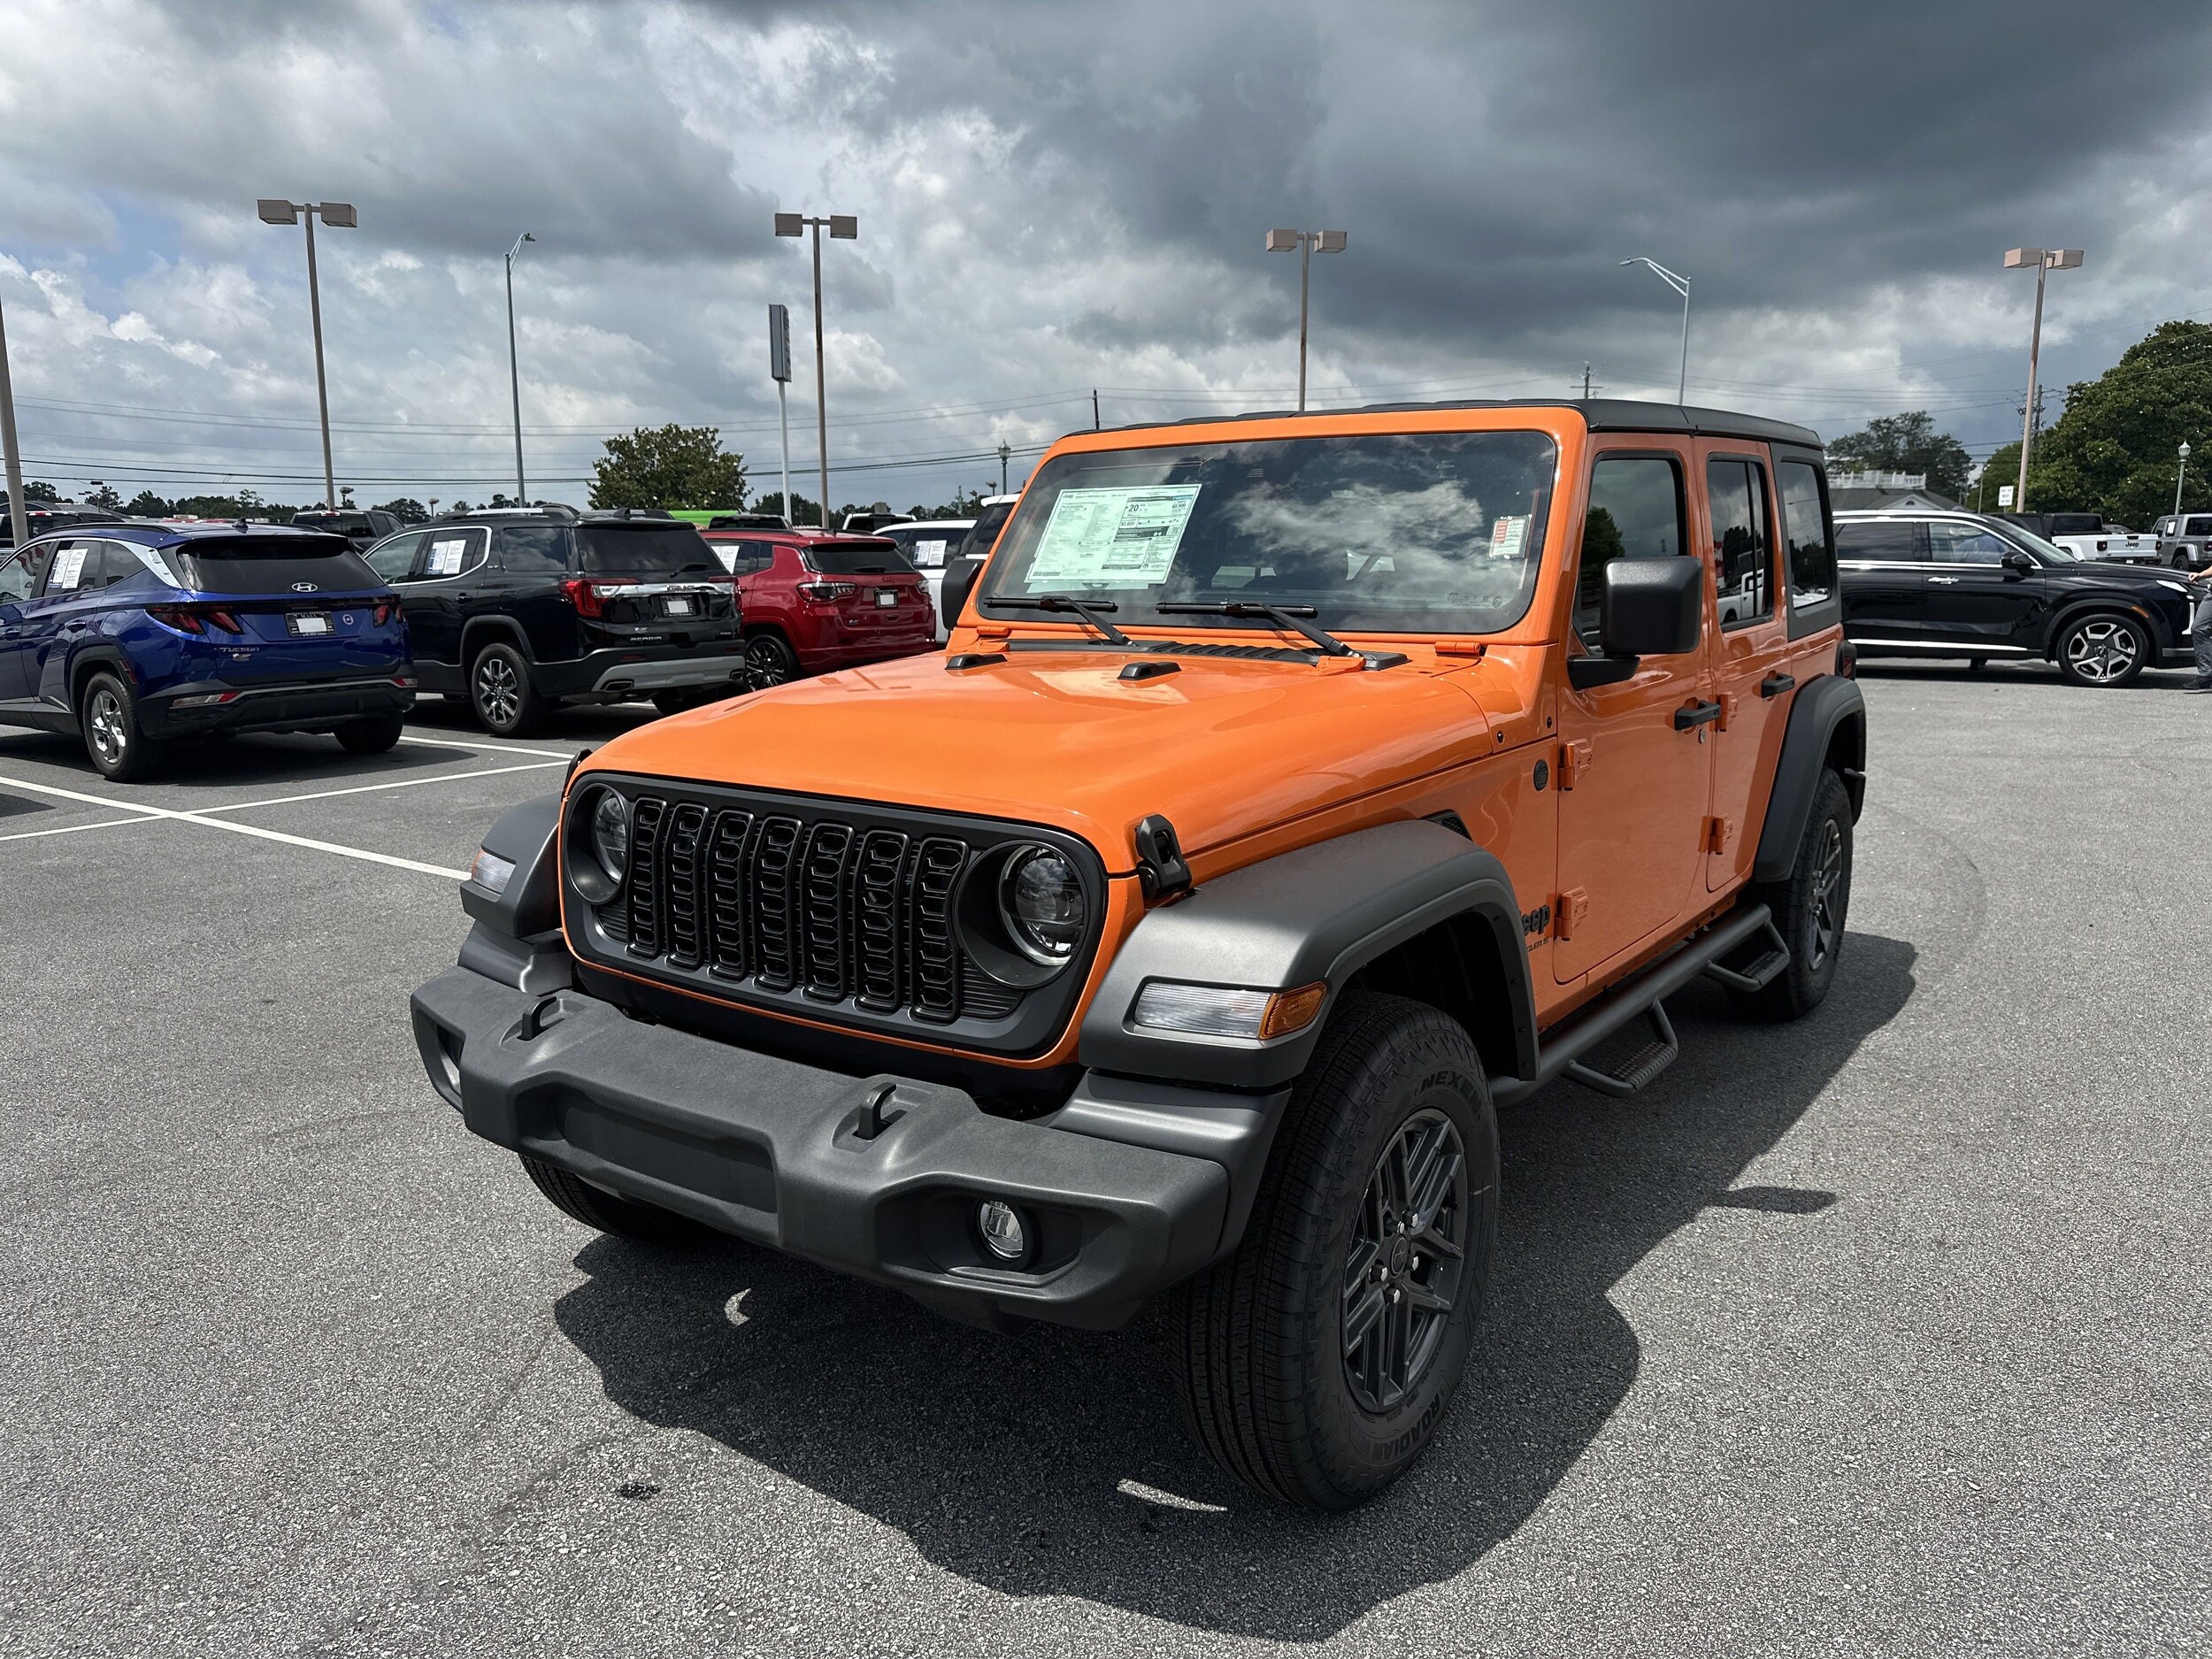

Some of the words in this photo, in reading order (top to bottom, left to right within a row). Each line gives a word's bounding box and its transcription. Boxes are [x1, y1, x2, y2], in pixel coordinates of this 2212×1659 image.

[1128, 503, 1140, 512] 20
[1519, 904, 1550, 936] eep
[1420, 1071, 1483, 1115] NEXEN
[1372, 1393, 1440, 1461] ROADIAN
